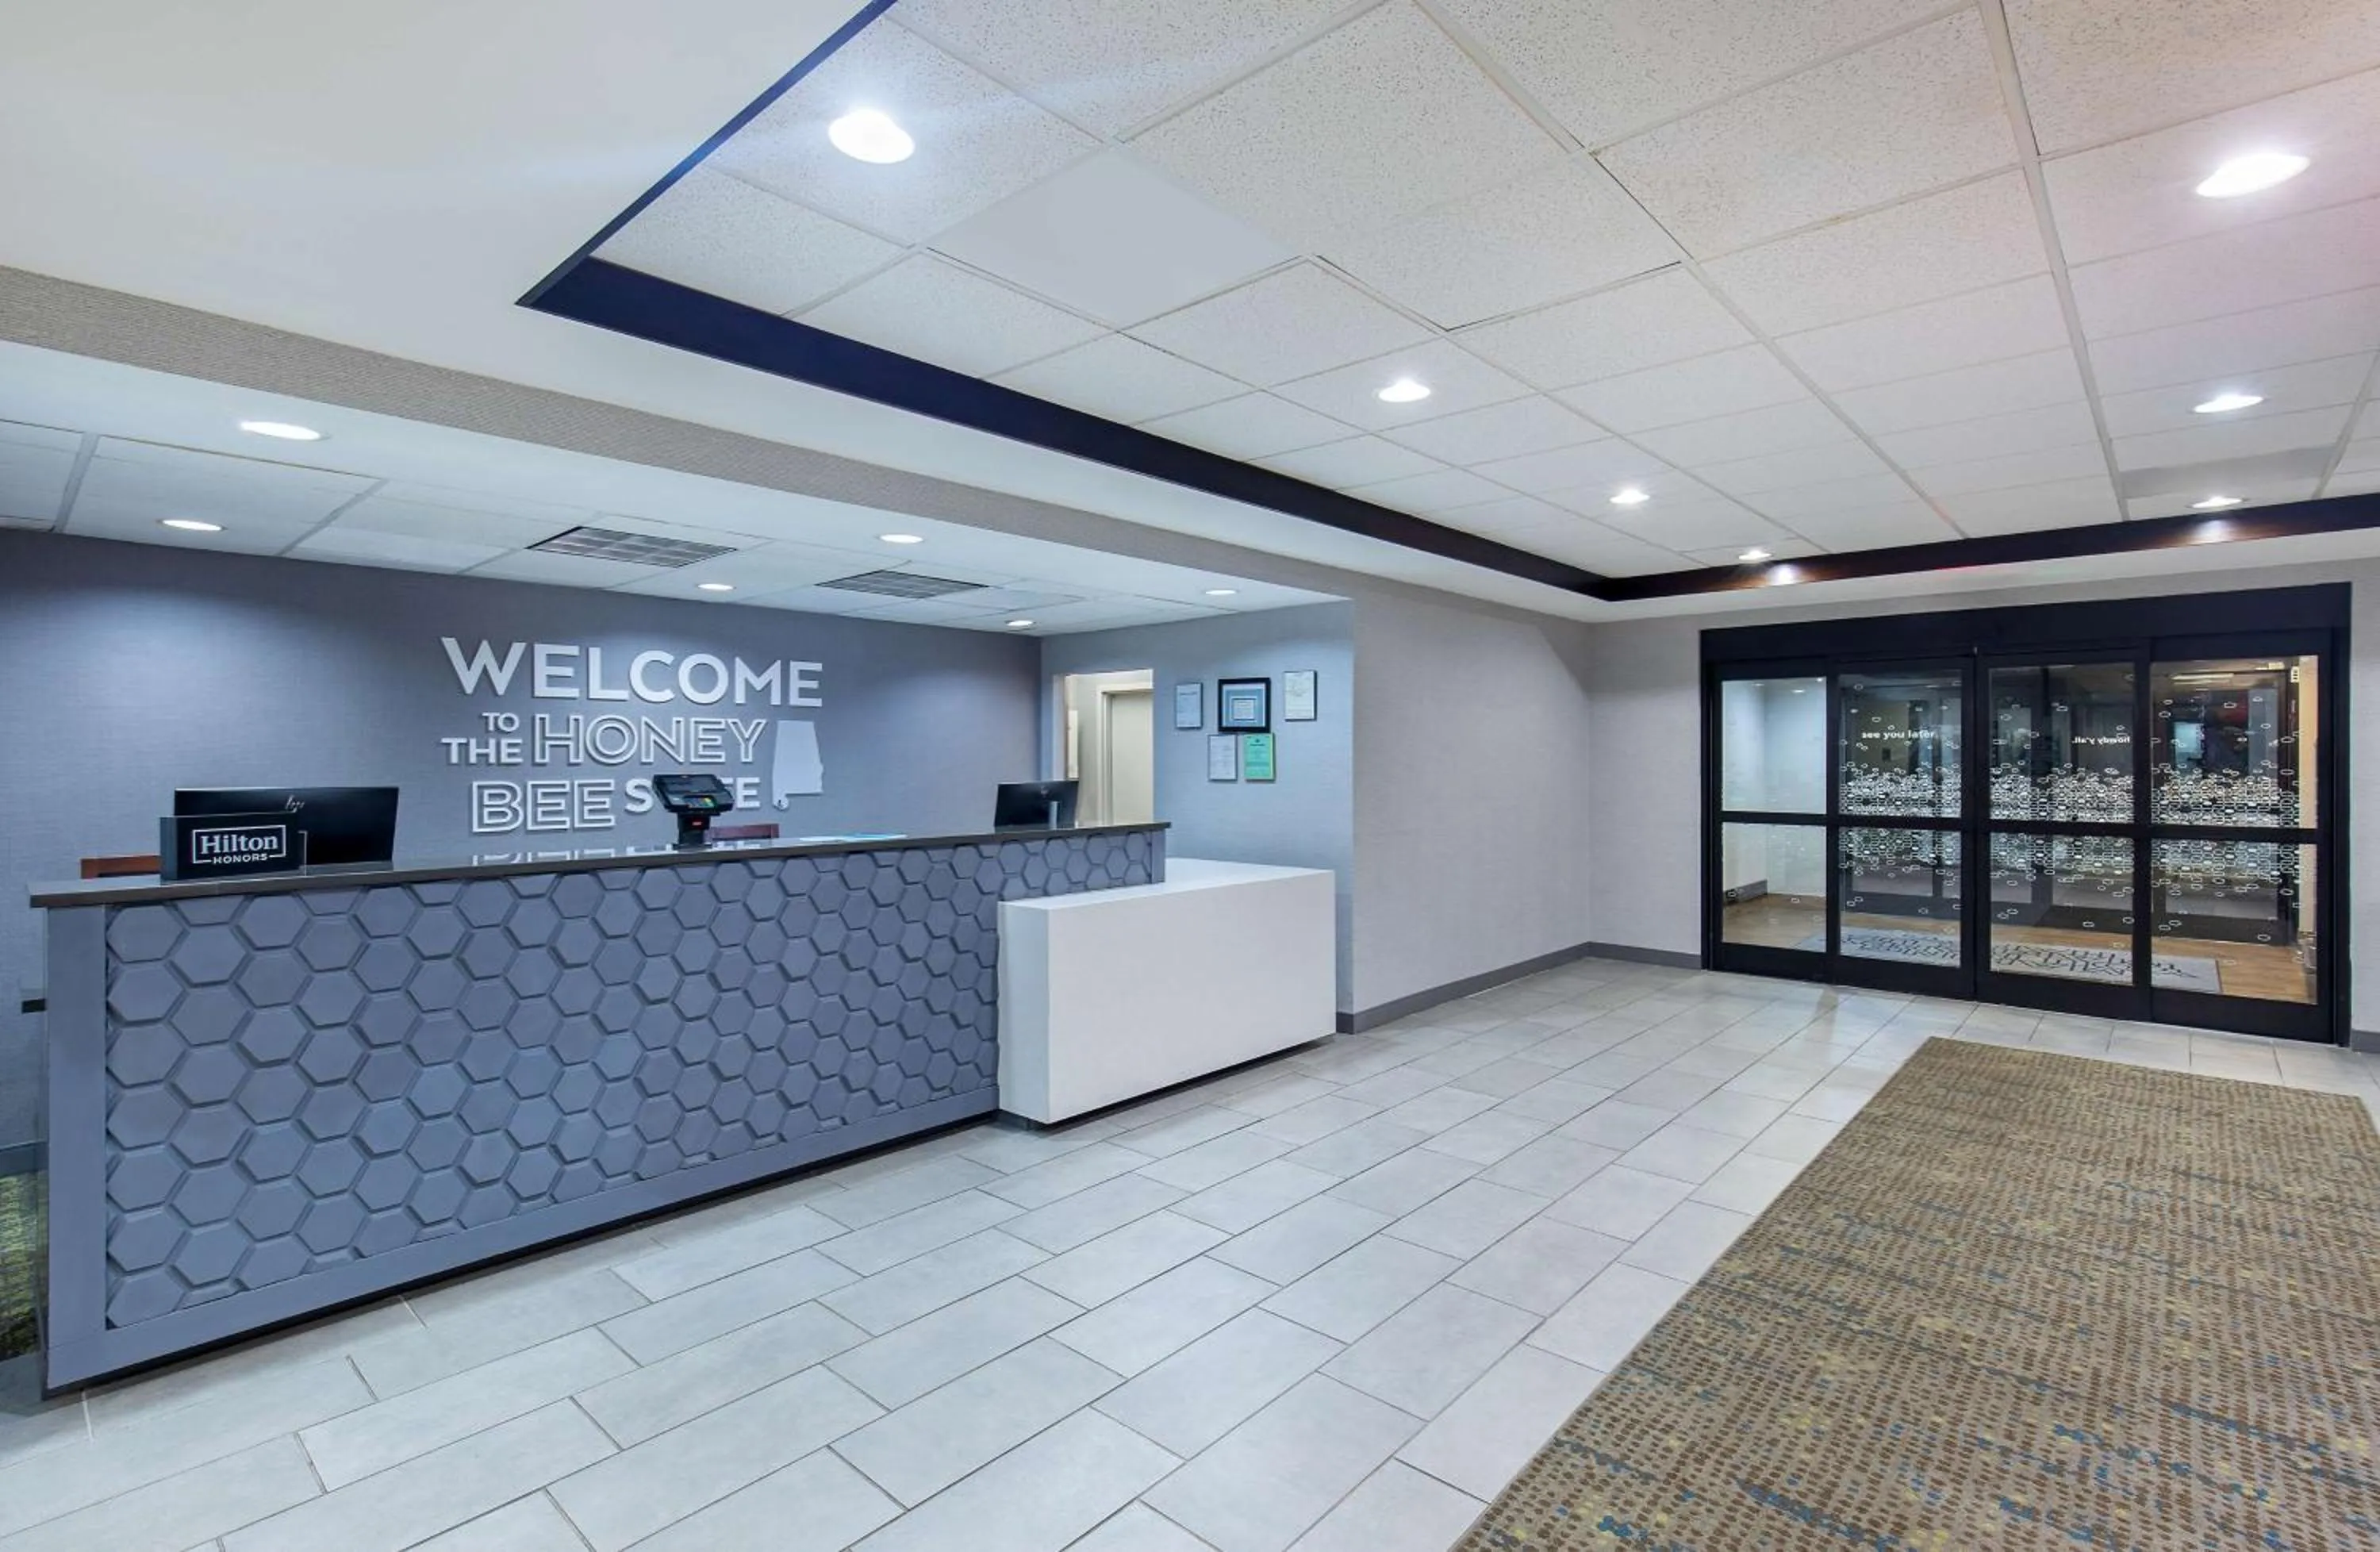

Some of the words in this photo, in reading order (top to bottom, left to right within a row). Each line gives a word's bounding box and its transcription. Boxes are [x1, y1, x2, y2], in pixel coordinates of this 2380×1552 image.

[441, 637, 823, 707] WELCOME
[482, 713, 520, 732] TO
[441, 738, 524, 764] THE
[533, 713, 766, 765] HONEY
[1883, 732, 1905, 740] you
[471, 778, 615, 832] BEE
[201, 834, 278, 855] Hilton
[213, 853, 268, 864] HONORS
